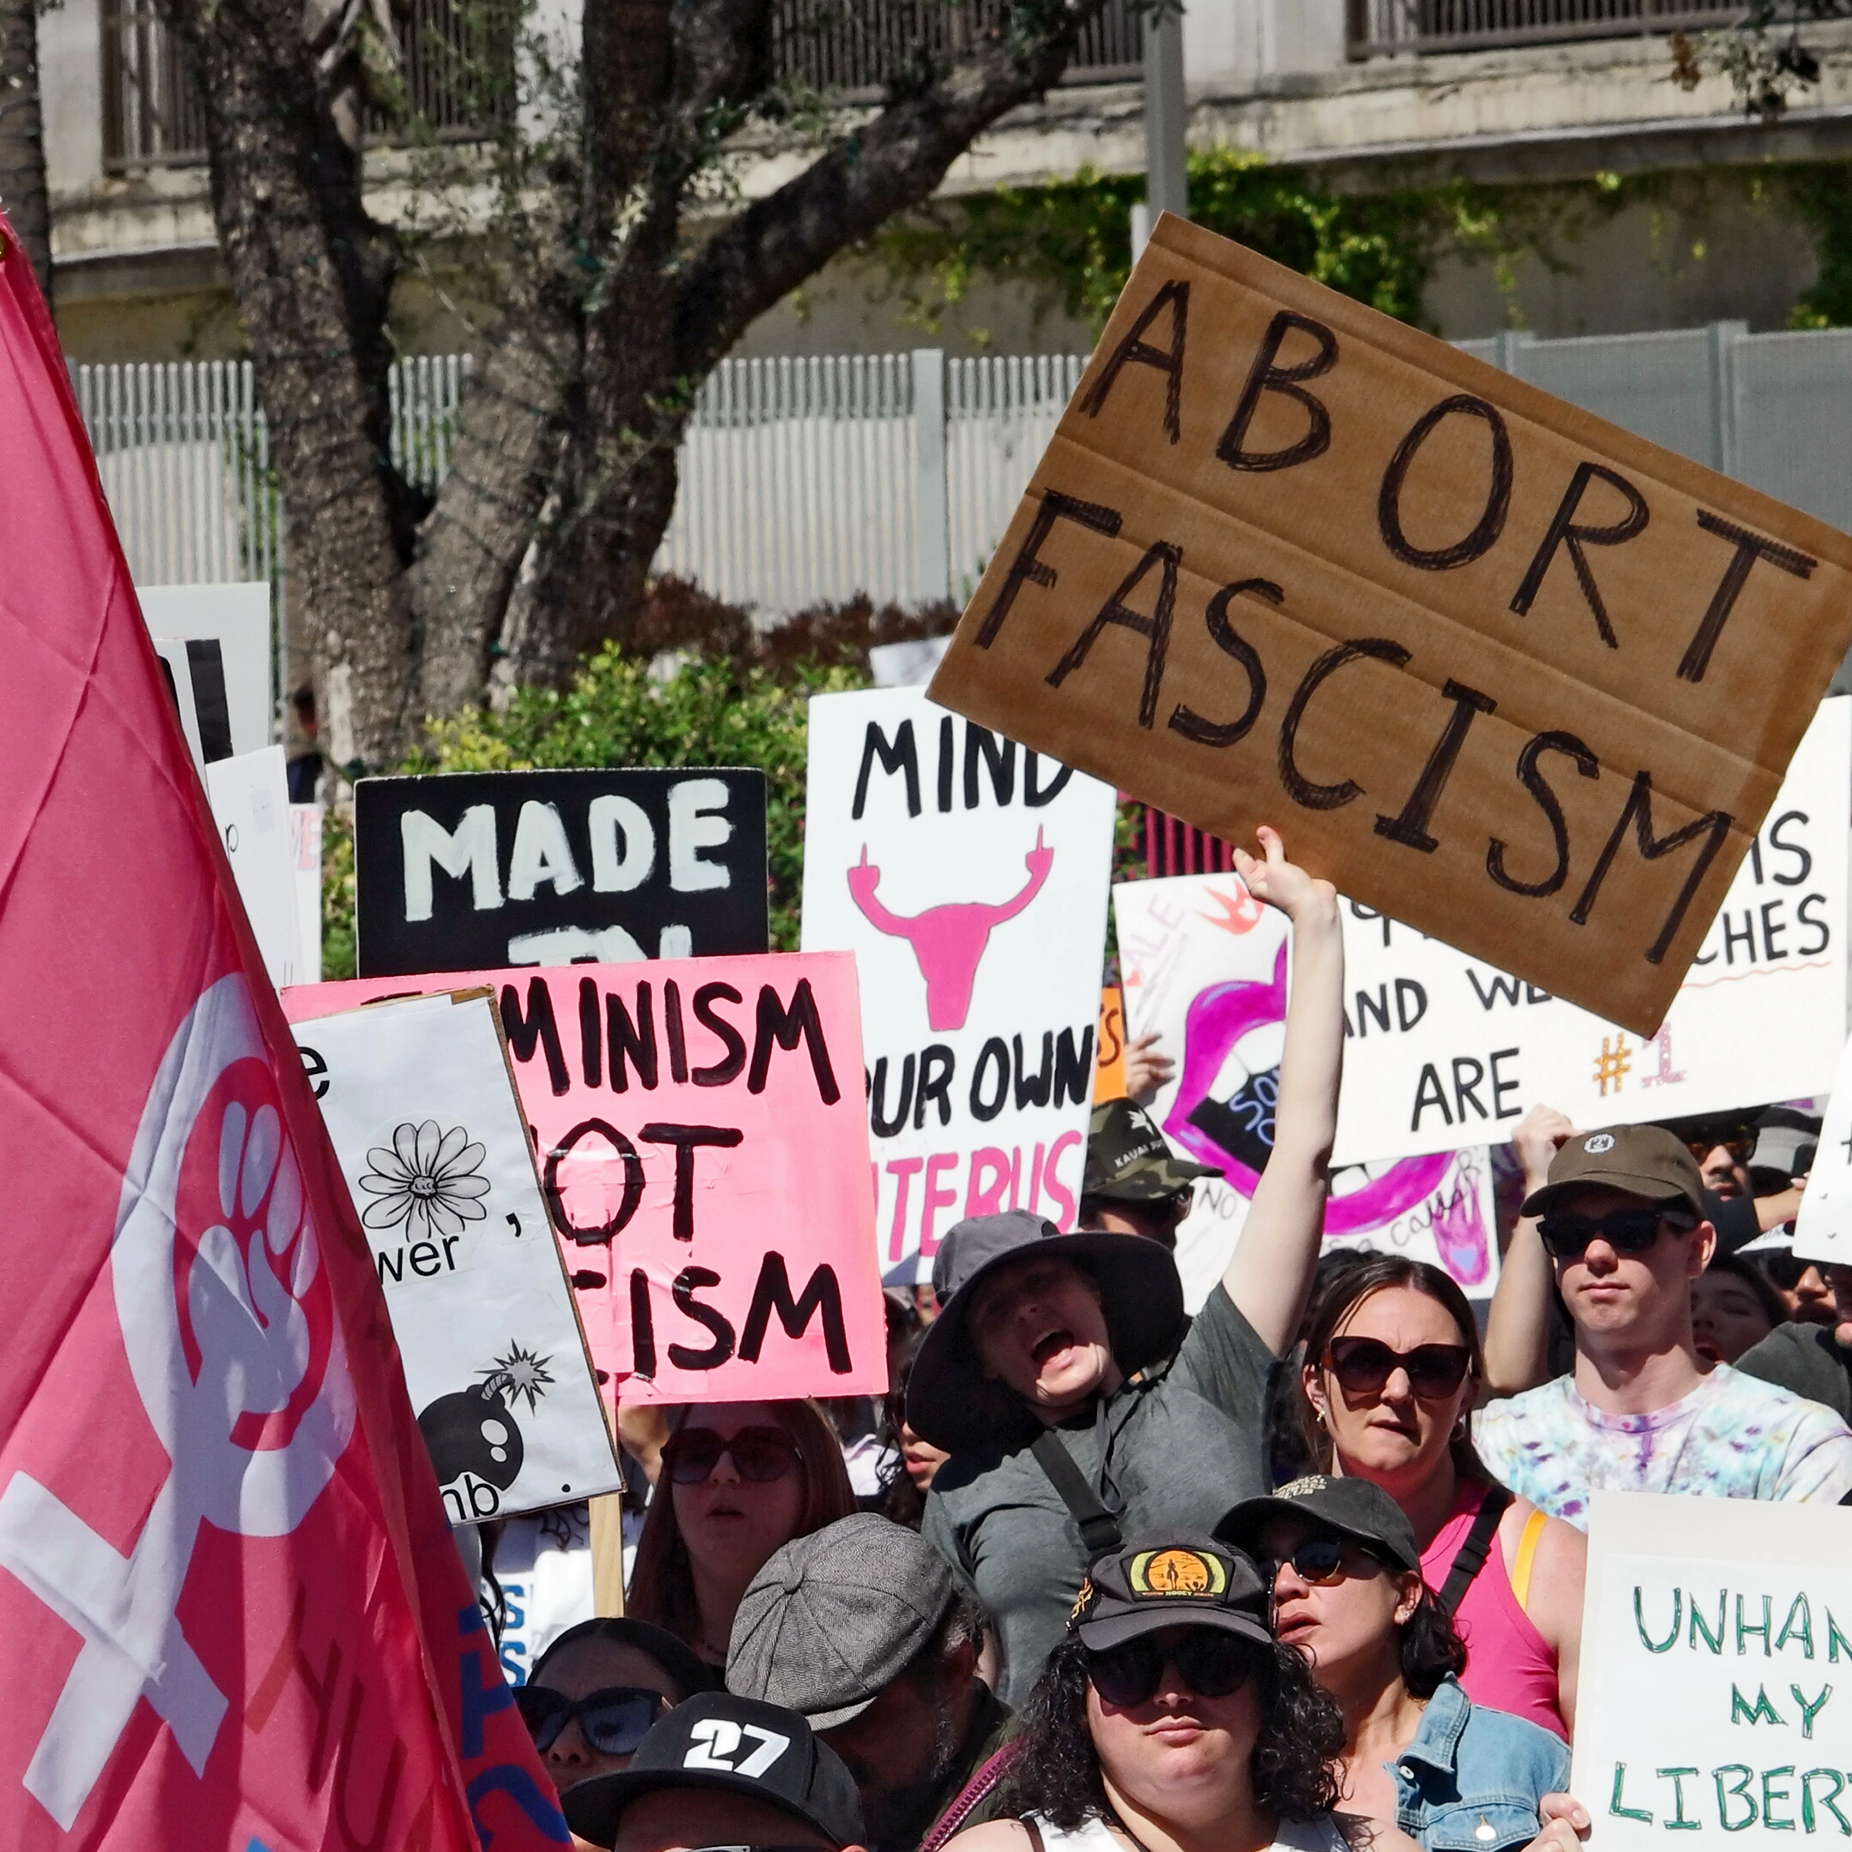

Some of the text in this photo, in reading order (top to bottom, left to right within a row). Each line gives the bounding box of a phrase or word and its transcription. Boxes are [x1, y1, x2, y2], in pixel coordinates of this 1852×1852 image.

[1077, 278, 1819, 685] ABORT
[975, 489, 1735, 966] FASCISM
[400, 776, 735, 922] MADE
[1345, 978, 1428, 1038] ND
[969, 1024, 1096, 1124] OWN
[1410, 1022, 1686, 1133] ARE #1
[538, 1123, 745, 1246] OT
[682, 1720, 790, 1779] 27
[1730, 1681, 1833, 1739] MY
